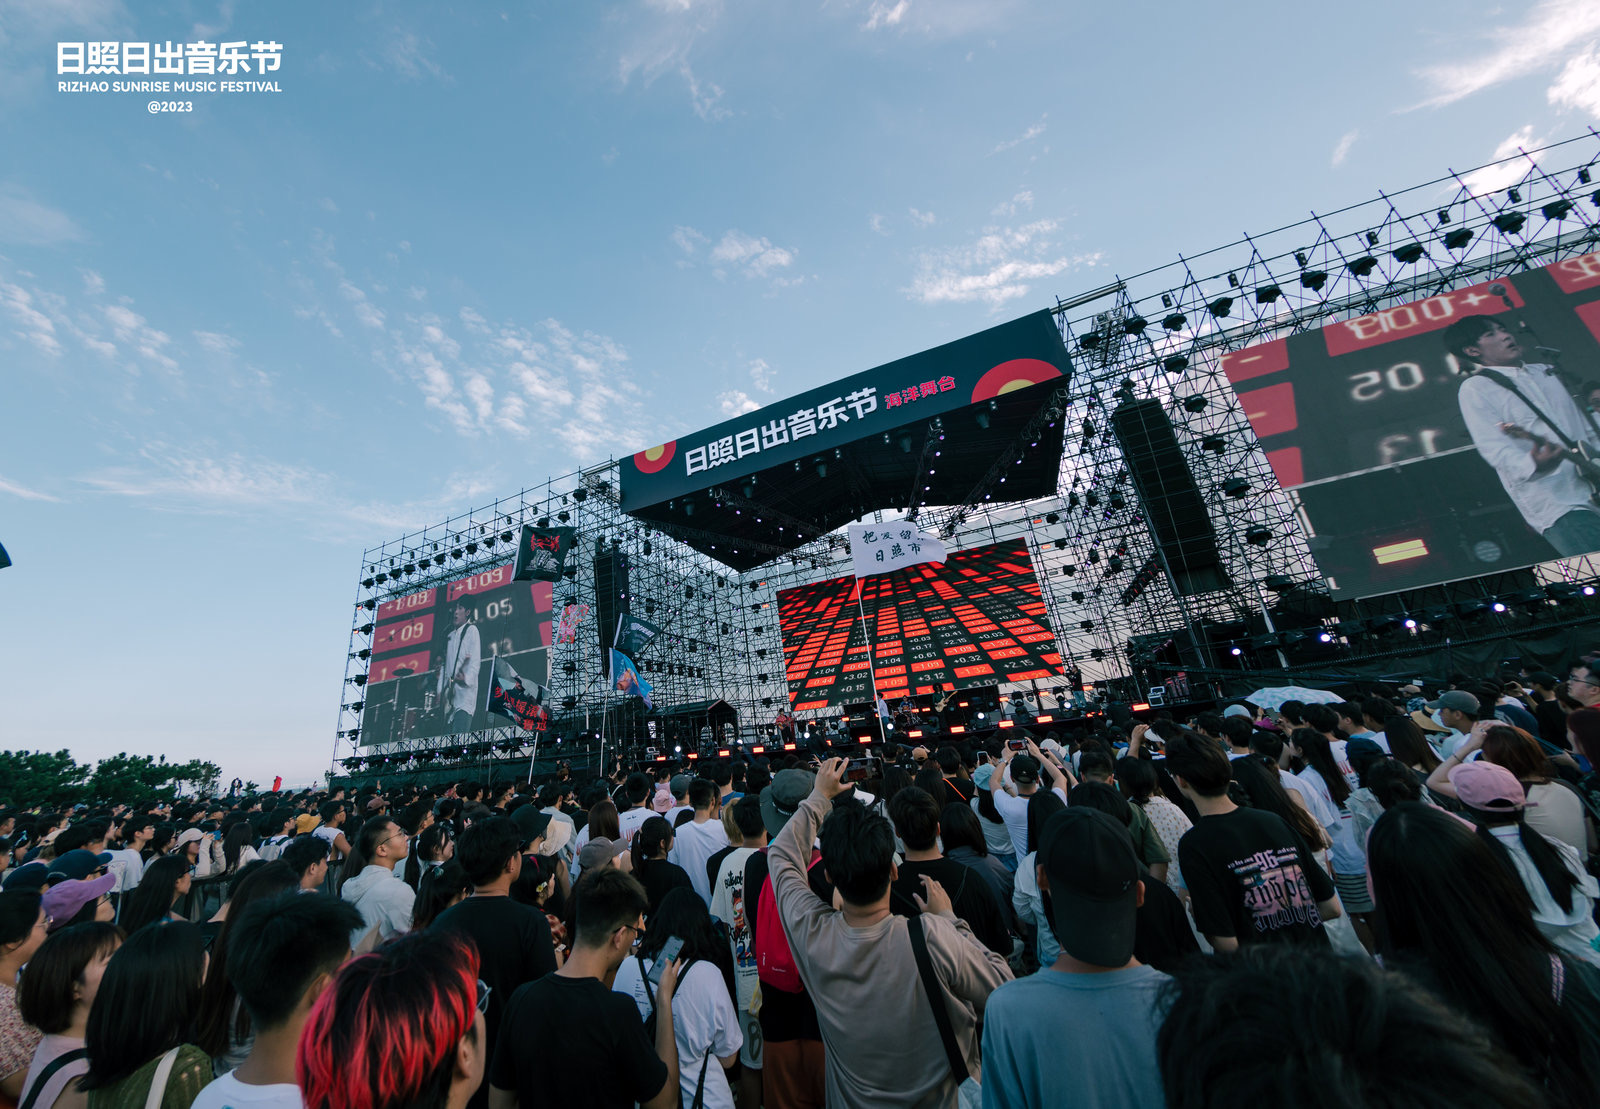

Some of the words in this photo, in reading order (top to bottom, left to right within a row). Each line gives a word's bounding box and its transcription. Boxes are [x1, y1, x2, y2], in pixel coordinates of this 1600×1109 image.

[884, 376, 956, 411] 海洋舞台
[685, 387, 877, 477] 日照日出音乐节
[875, 542, 922, 562] 日照市
